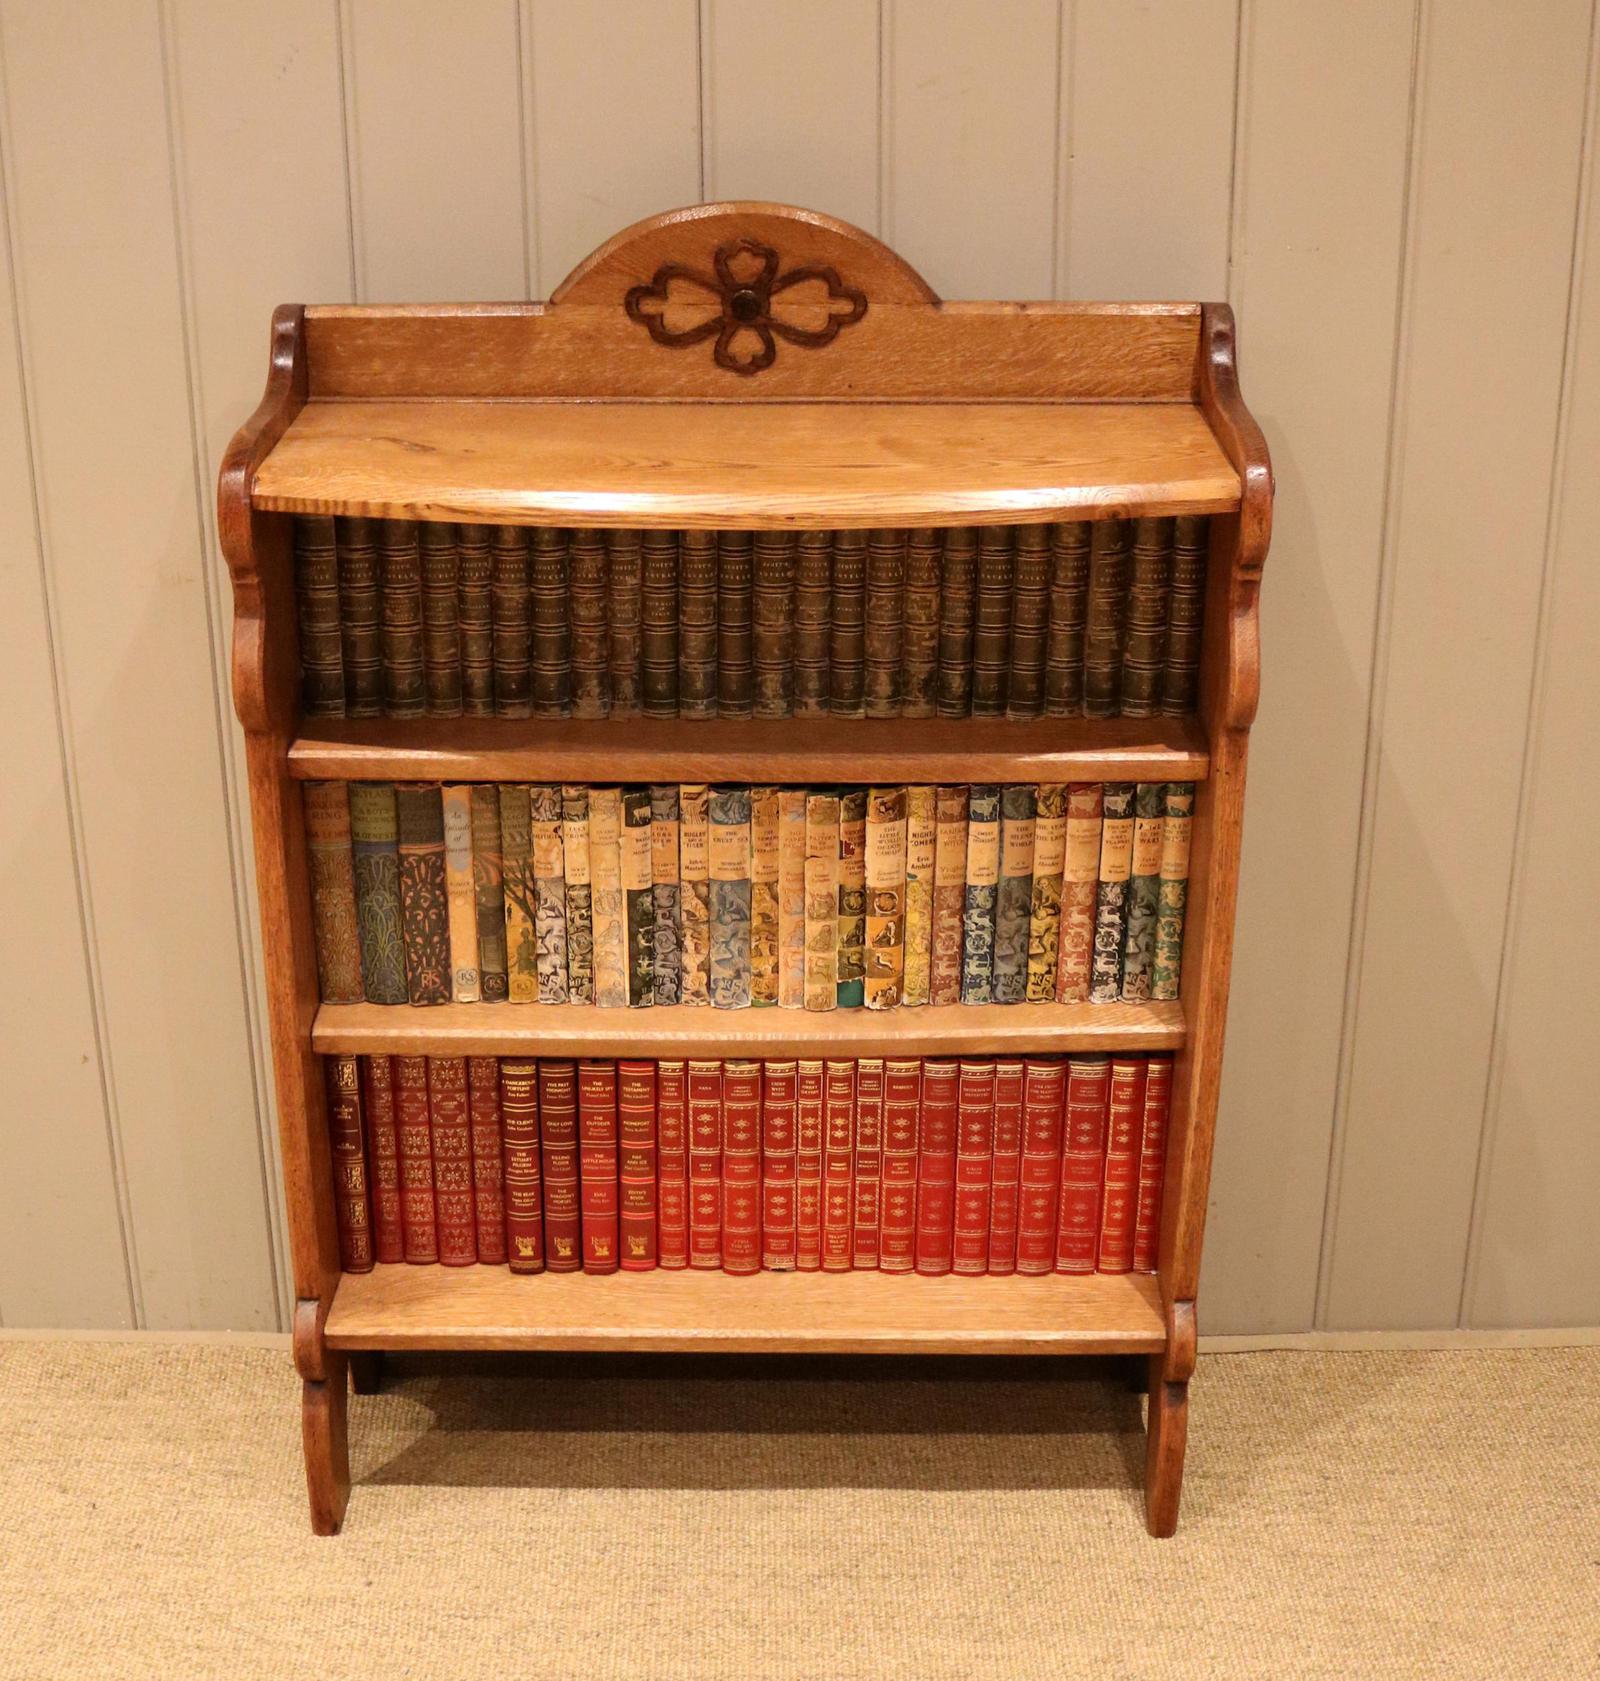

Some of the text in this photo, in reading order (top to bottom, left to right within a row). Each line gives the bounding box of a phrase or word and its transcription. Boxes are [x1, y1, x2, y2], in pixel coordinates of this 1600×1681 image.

[311, 811, 342, 820] RING
[1009, 840, 1033, 848] WORLD
[1139, 837, 1160, 845] WARS
